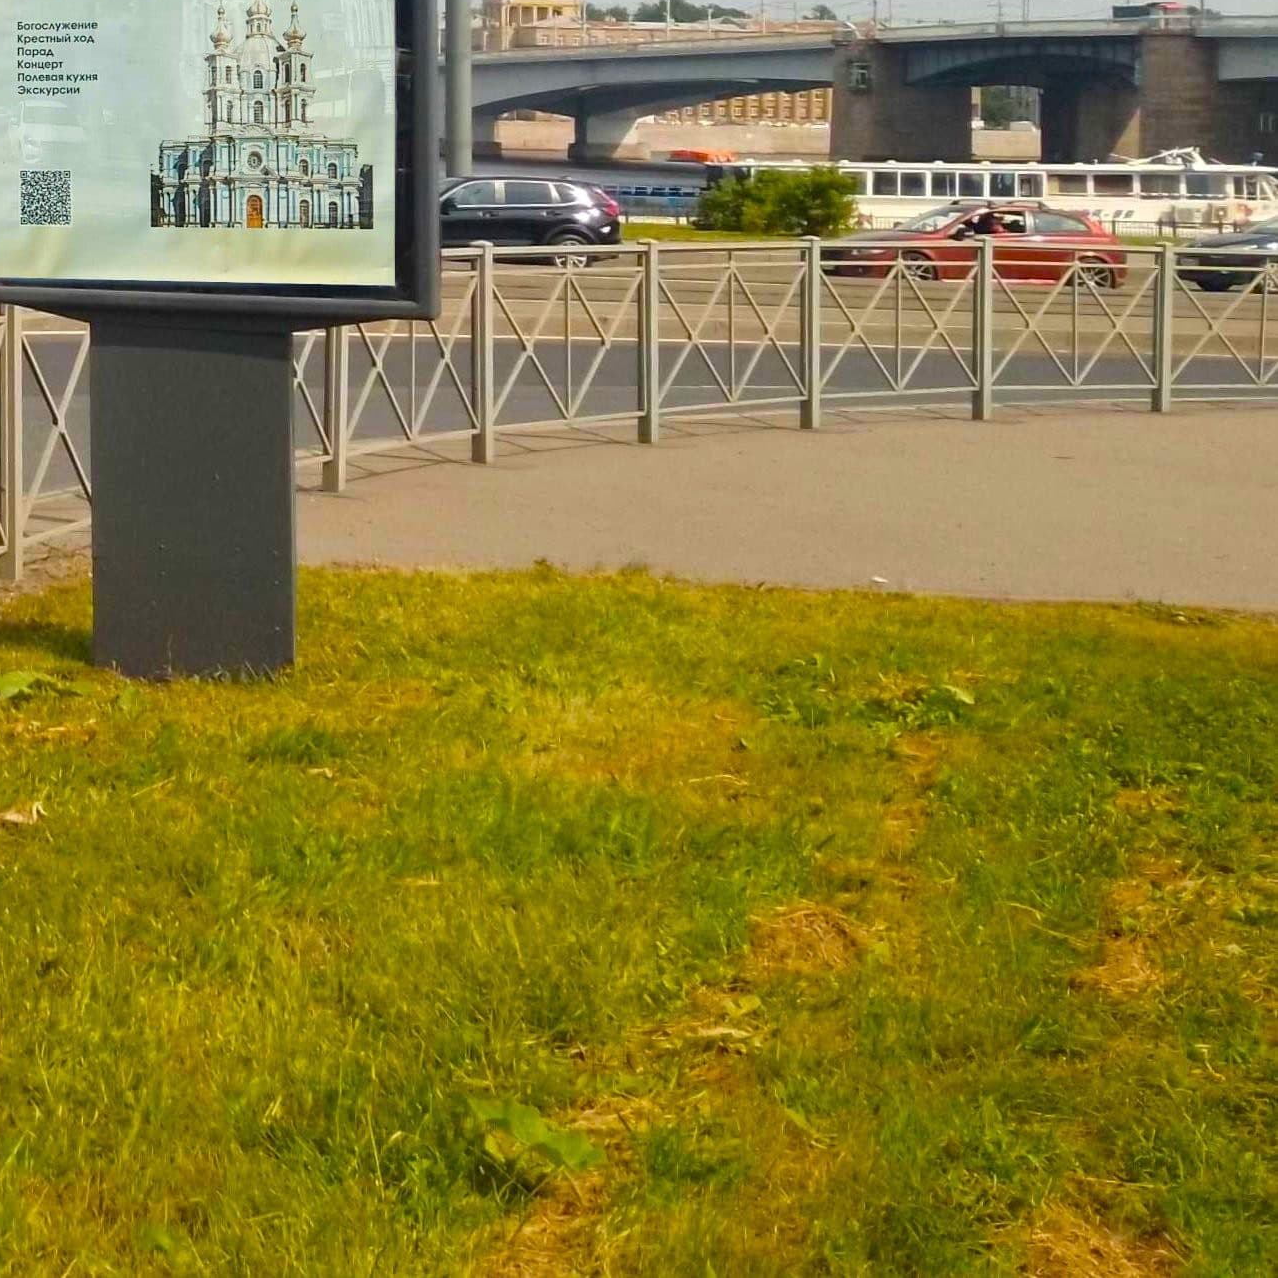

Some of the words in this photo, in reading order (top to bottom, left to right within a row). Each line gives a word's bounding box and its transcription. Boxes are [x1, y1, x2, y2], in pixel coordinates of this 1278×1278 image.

[17, 21, 98, 32] Богослужение
[17, 33, 71, 45] Крестный
[73, 34, 95, 44] ход
[17, 47, 54, 58] Парад
[17, 59, 64, 70] Концерт
[17, 72, 64, 82] Полевая
[66, 73, 98, 83] кухня
[17, 85, 80, 96] Экскурсии
